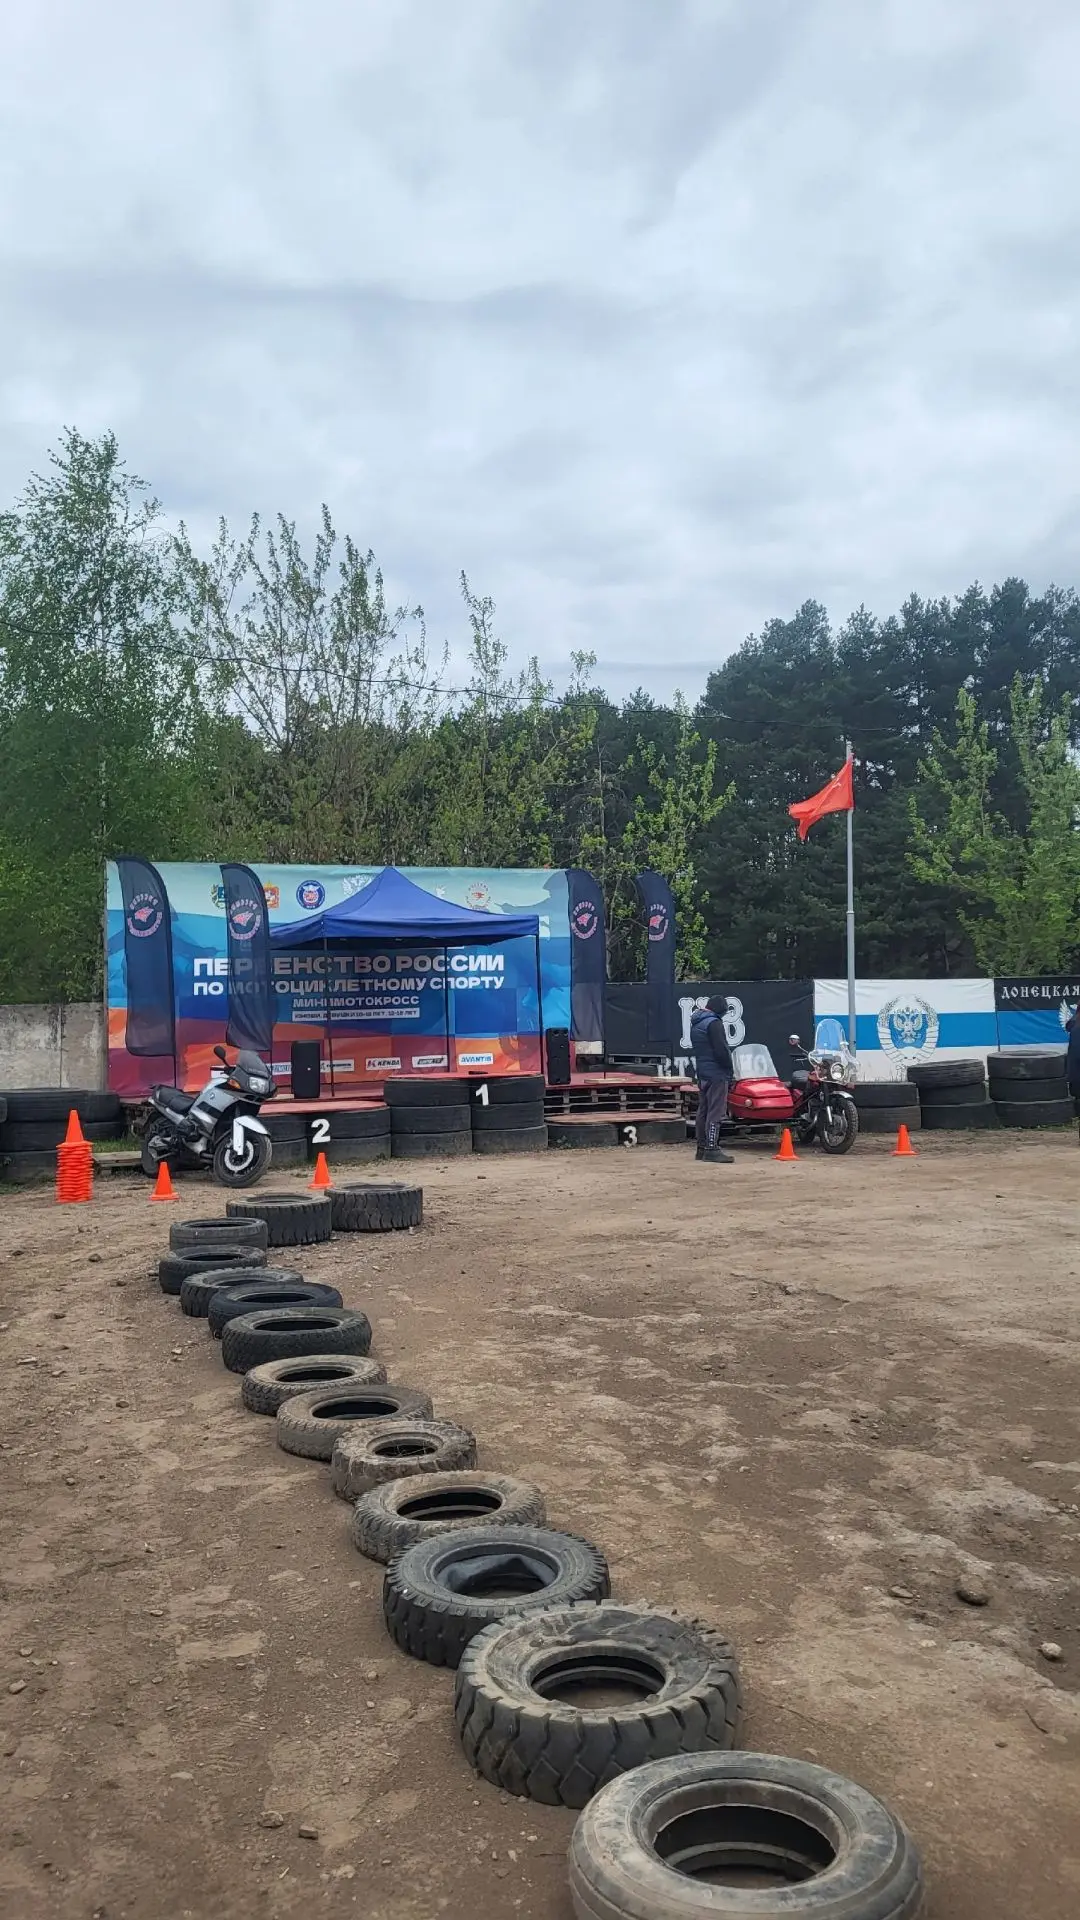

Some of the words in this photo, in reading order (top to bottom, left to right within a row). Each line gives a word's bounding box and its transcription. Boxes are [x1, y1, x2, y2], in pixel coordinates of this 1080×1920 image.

[396, 954, 504, 973] РОССИИ
[193, 981, 224, 996] ПО
[429, 976, 504, 990] СПОРТУ
[1001, 984, 1080, 999] ДОНЕЦКАЯ
[293, 995, 420, 1008] МИНИМОТОКРОСС
[378, 1059, 400, 1067] KENDA
[475, 1083, 489, 1106] 1
[311, 1118, 331, 1144] 2
[623, 1125, 638, 1148] 3
